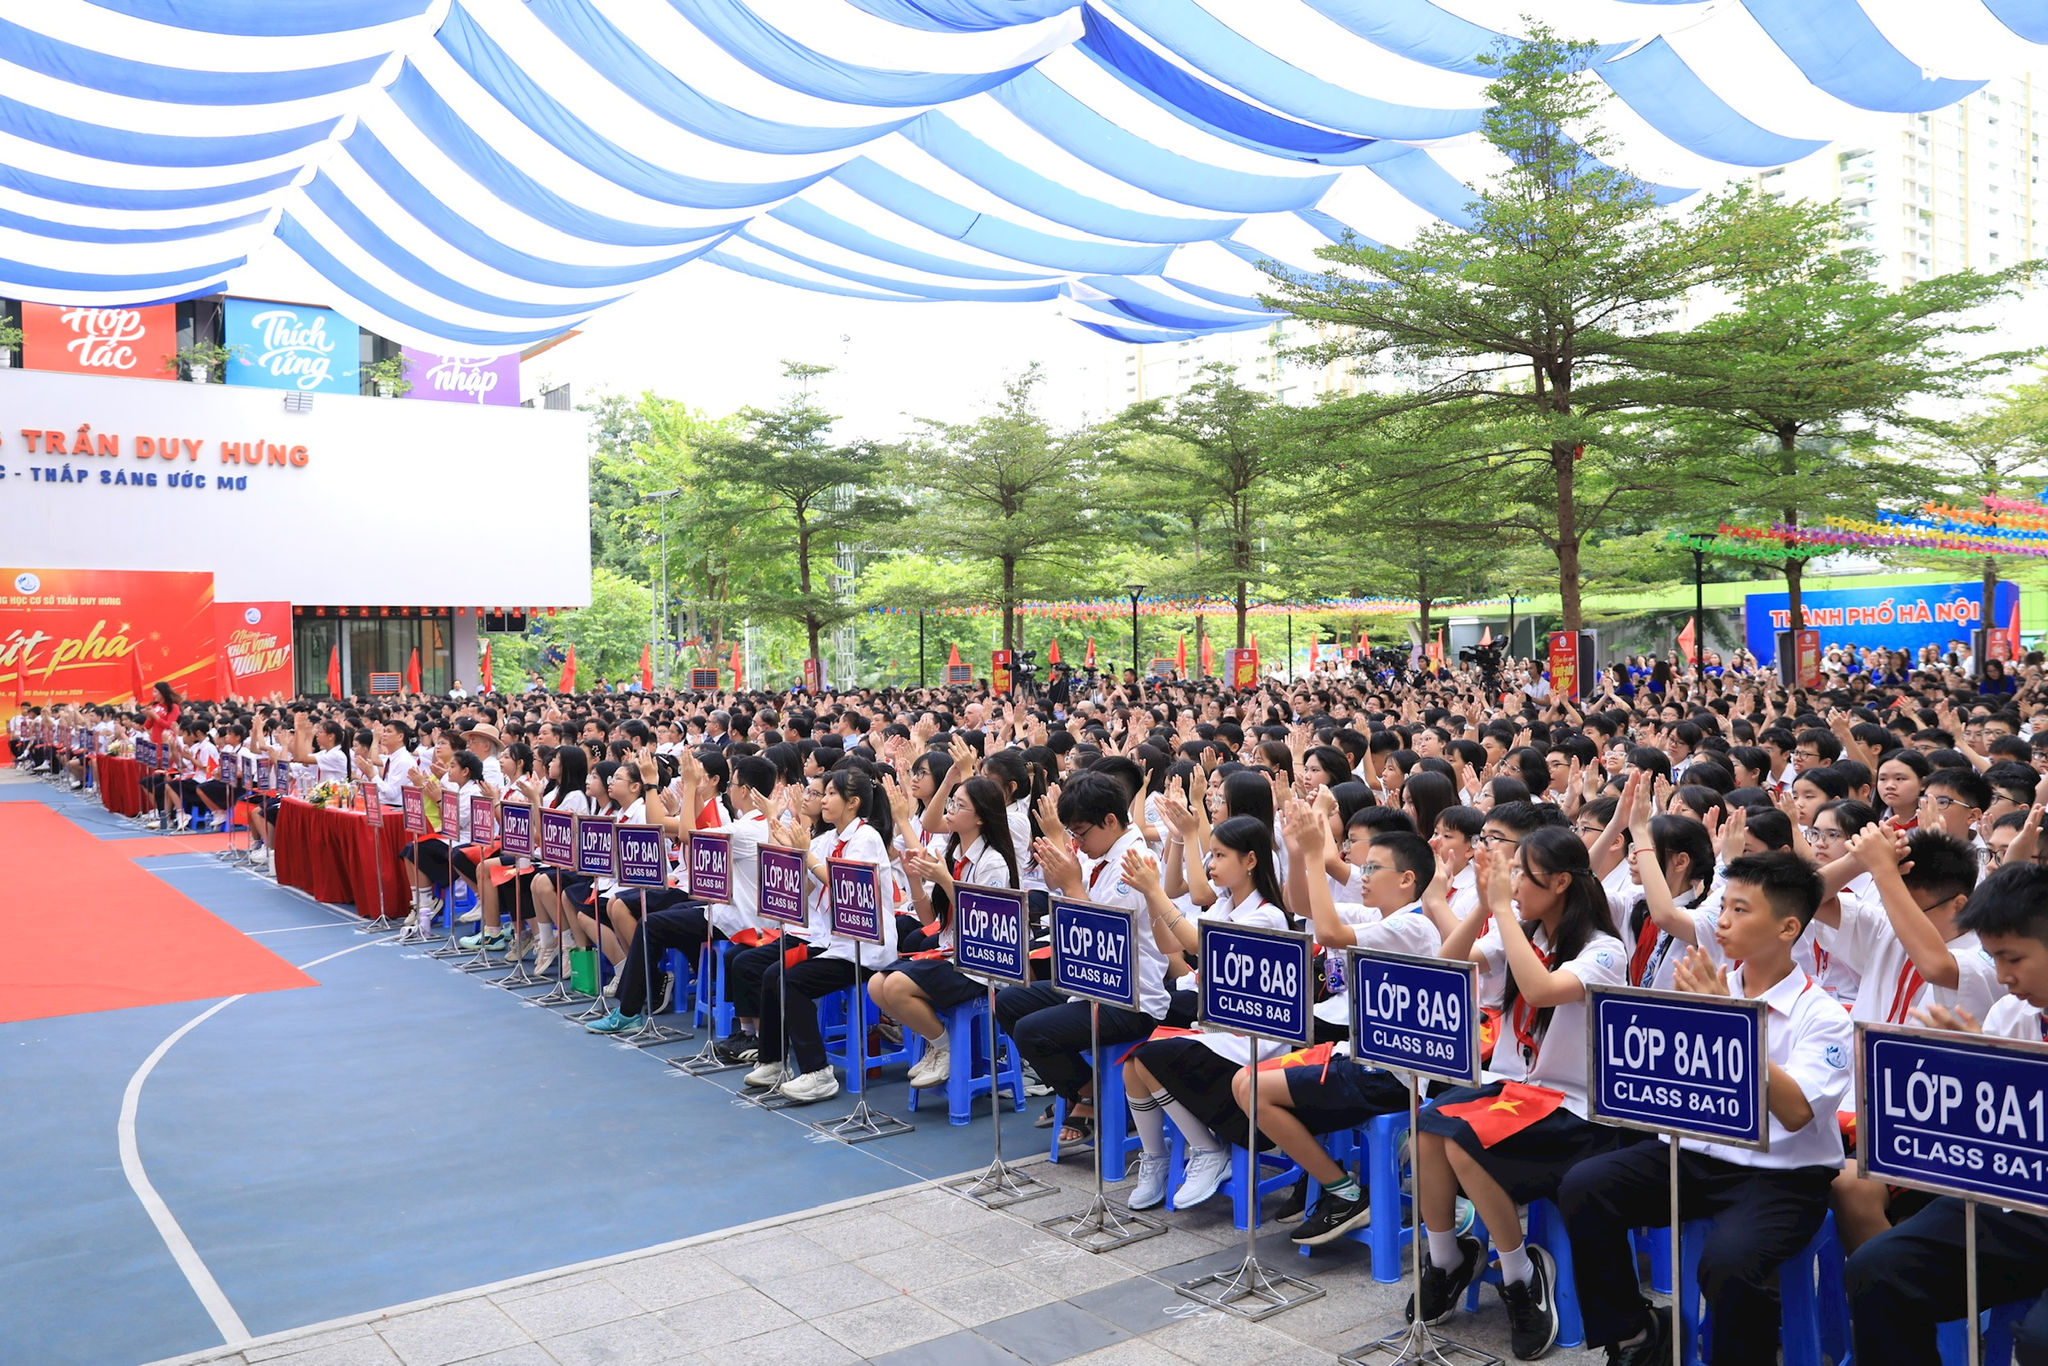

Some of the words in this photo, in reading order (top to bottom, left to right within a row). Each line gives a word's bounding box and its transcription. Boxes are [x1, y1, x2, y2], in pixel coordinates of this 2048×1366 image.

[251, 310, 335, 352] Thích
[21, 423, 119, 457] TRẦN
[136, 436, 204, 461] DUY
[221, 439, 309, 467] HƯNG
[100, 469, 157, 487] SÁNG
[168, 470, 205, 488] ƯỚC
[217, 475, 247, 491] MƠ
[10, 597, 27, 606] HỌC
[29, 596, 41, 605] CƠ
[80, 597, 96, 605] DUY
[1847, 598, 1894, 626] PHỐ
[1898, 599, 1932, 625] HÀ
[1935, 597, 1980, 626] NỘI
[504, 811, 516, 833] LỚP
[517, 818, 529, 835] 7A7
[544, 820, 556, 842] LỚP
[557, 827, 571, 844] 7A8
[506, 837, 520, 847] CLASS
[546, 847, 560, 856] CLASS
[583, 828, 597, 851] LỚP
[598, 833, 612, 852] 7A9
[621, 836, 639, 862] LỚP
[642, 842, 659, 863] 8A0
[584, 857, 599, 865] CLASS
[625, 867, 645, 876] CLASS
[645, 869, 657, 878] 8A0
[694, 845, 710, 871] LỚP
[712, 851, 727, 873] 8A1
[696, 877, 714, 887] CLASS
[714, 879, 724, 890] 8A1
[764, 860, 782, 888] LỚP
[784, 870, 800, 894] 8A2
[767, 896, 787, 907] CLASS
[787, 900, 797, 911] 8A2
[834, 874, 855, 905] LỚP
[857, 883, 875, 910] 8A3
[839, 912, 861, 925] CLASS
[861, 916, 874, 928] 8A3
[962, 902, 988, 939] LỚP
[992, 913, 1018, 945] 8A6
[1060, 917, 1093, 957] LỚP
[1097, 930, 1125, 965] 8A7
[966, 946, 995, 962] CLASS
[997, 951, 1014, 966] 8A6
[1067, 965, 1100, 983] CLASS
[1103, 972, 1122, 988] 8A7
[1212, 944, 1254, 988] LỚP
[1259, 958, 1297, 998] 8A8
[1219, 996, 1262, 1018] CLASS
[1266, 1005, 1291, 1023] 8A8
[1364, 972, 1410, 1022] LỚP
[1416, 988, 1461, 1033] 8A9
[1373, 1029, 1422, 1052] CLASS
[1425, 1038, 1455, 1061] 8A9
[1607, 1015, 1666, 1071] LỚP
[1674, 1031, 1744, 1084] 8A10
[1613, 1081, 1683, 1108] CLASS
[1688, 1094, 1740, 1117] 8A10
[1884, 1058, 1963, 1125] LỚP
[1893, 1135, 1984, 1170] CLASS
[1992, 1153, 2048, 1182] 8A1
